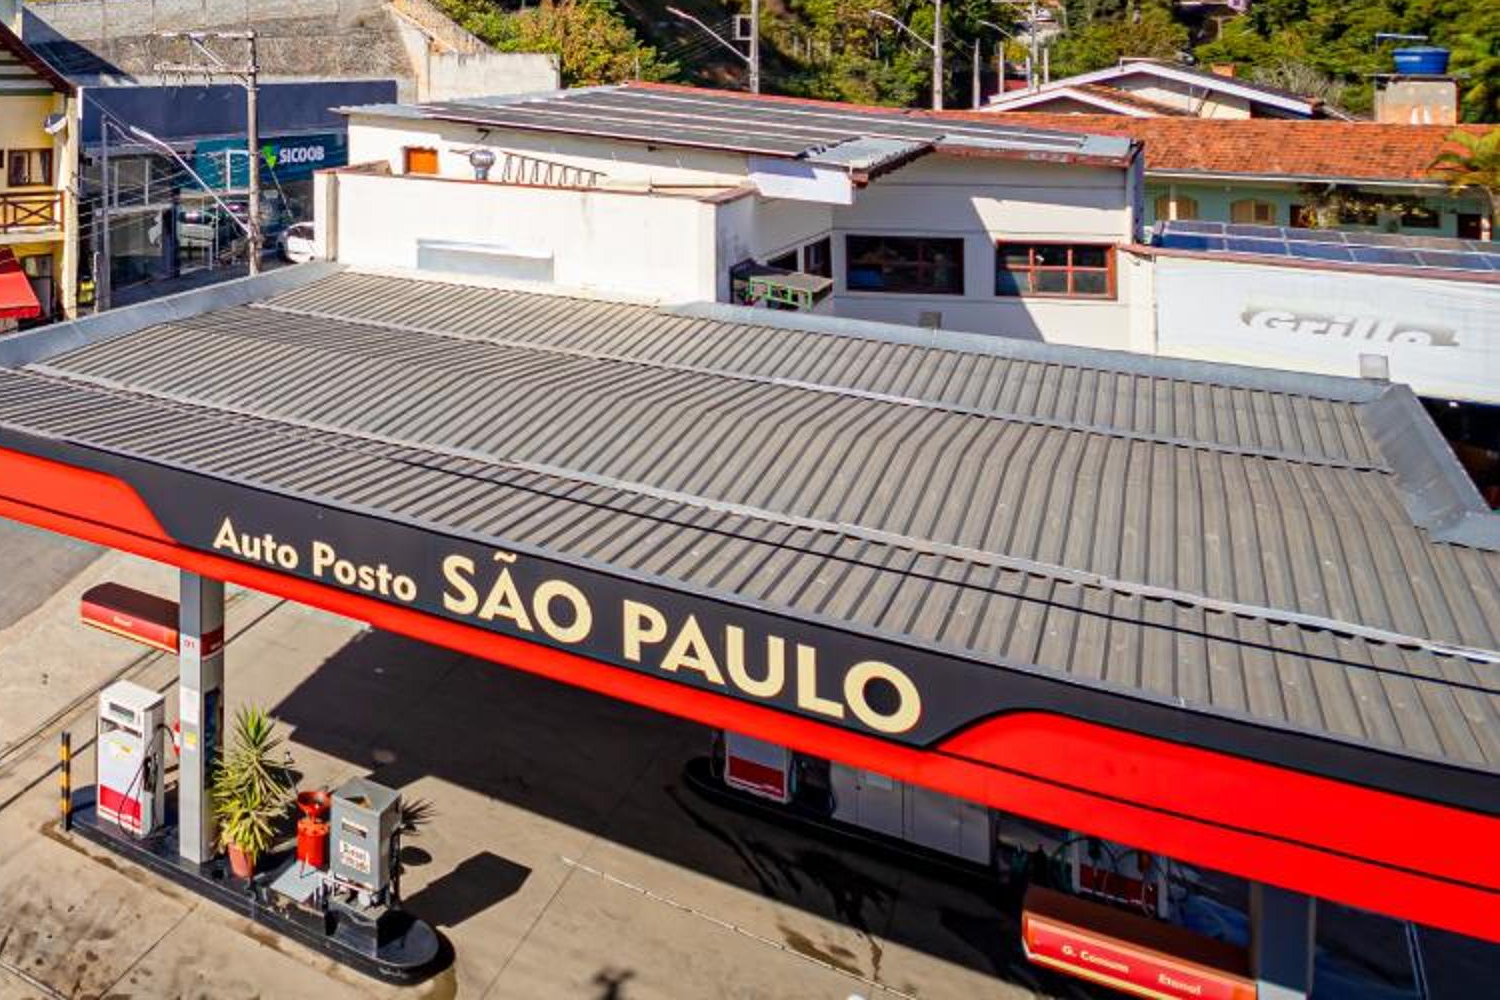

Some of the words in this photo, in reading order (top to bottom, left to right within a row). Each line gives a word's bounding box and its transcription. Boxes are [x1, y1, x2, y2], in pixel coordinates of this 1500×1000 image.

[279, 145, 325, 164] SICOOB
[213, 516, 299, 570] Auto
[312, 541, 418, 602] Posto
[442, 550, 593, 644] SÃO
[623, 599, 922, 734] PAULO
